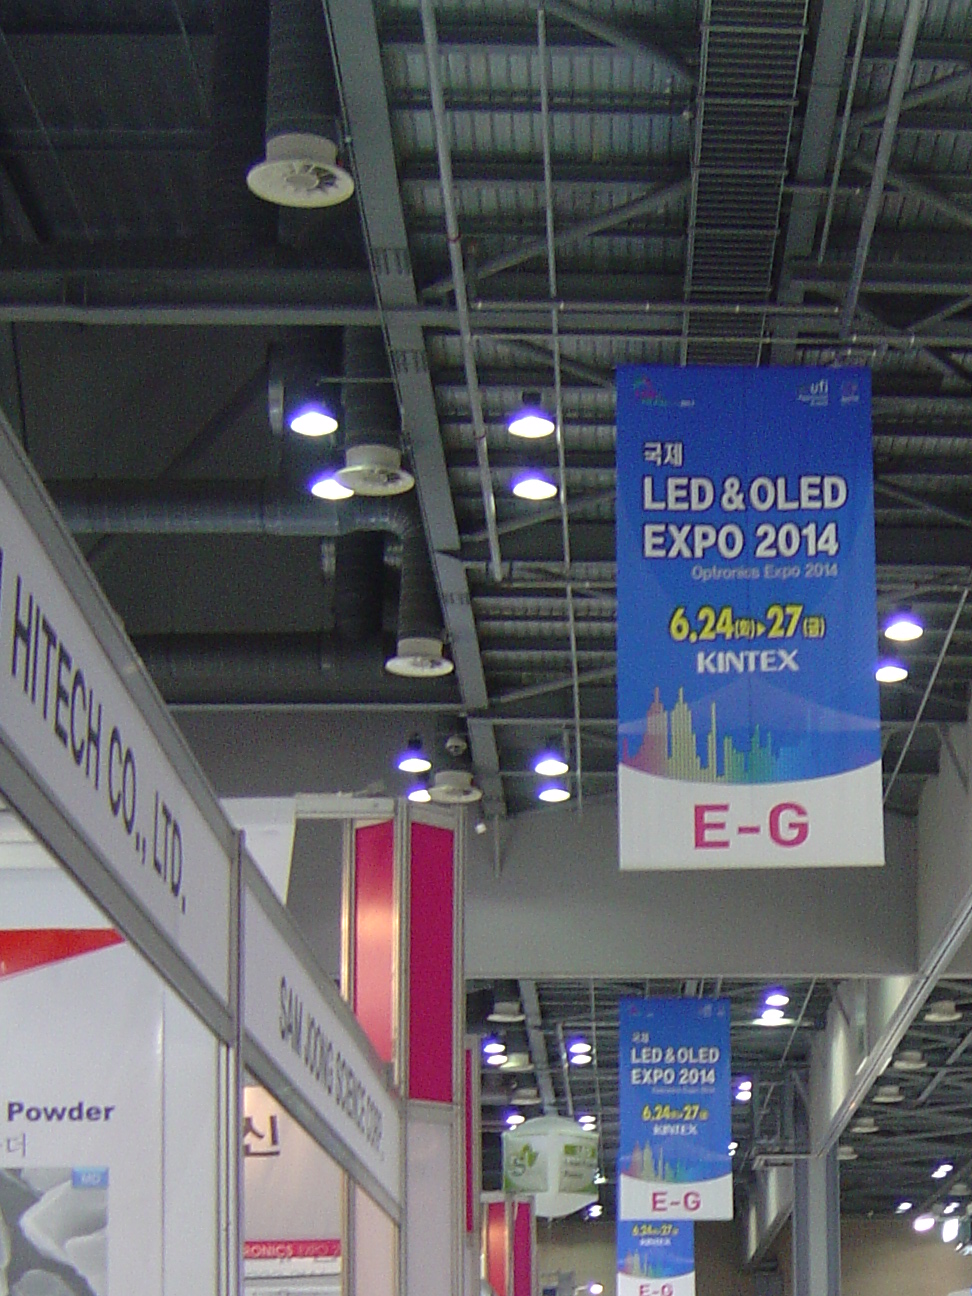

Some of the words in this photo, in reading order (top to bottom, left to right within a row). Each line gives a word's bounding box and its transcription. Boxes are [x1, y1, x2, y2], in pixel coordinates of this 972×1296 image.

[643, 441, 683, 467] 국제
[643, 476, 714, 511] LED
[720, 476, 746, 511] &
[750, 475, 848, 511] OLED
[643, 523, 745, 559] EXPO
[755, 522, 840, 558] 2014
[690, 564, 761, 582] Optronics
[763, 565, 801, 581] Expo
[804, 562, 839, 577] 2014
[696, 649, 800, 674] KINTEX
[11, 573, 103, 792] HITECH
[693, 802, 810, 850] E-G
[630, 1047, 661, 1064] LED
[677, 1046, 720, 1064] OLED
[631, 1068, 674, 1085] EXPO
[678, 1068, 717, 1085] 2014
[6, 1101, 116, 1123] Powder
[650, 1191, 702, 1213] E-G
